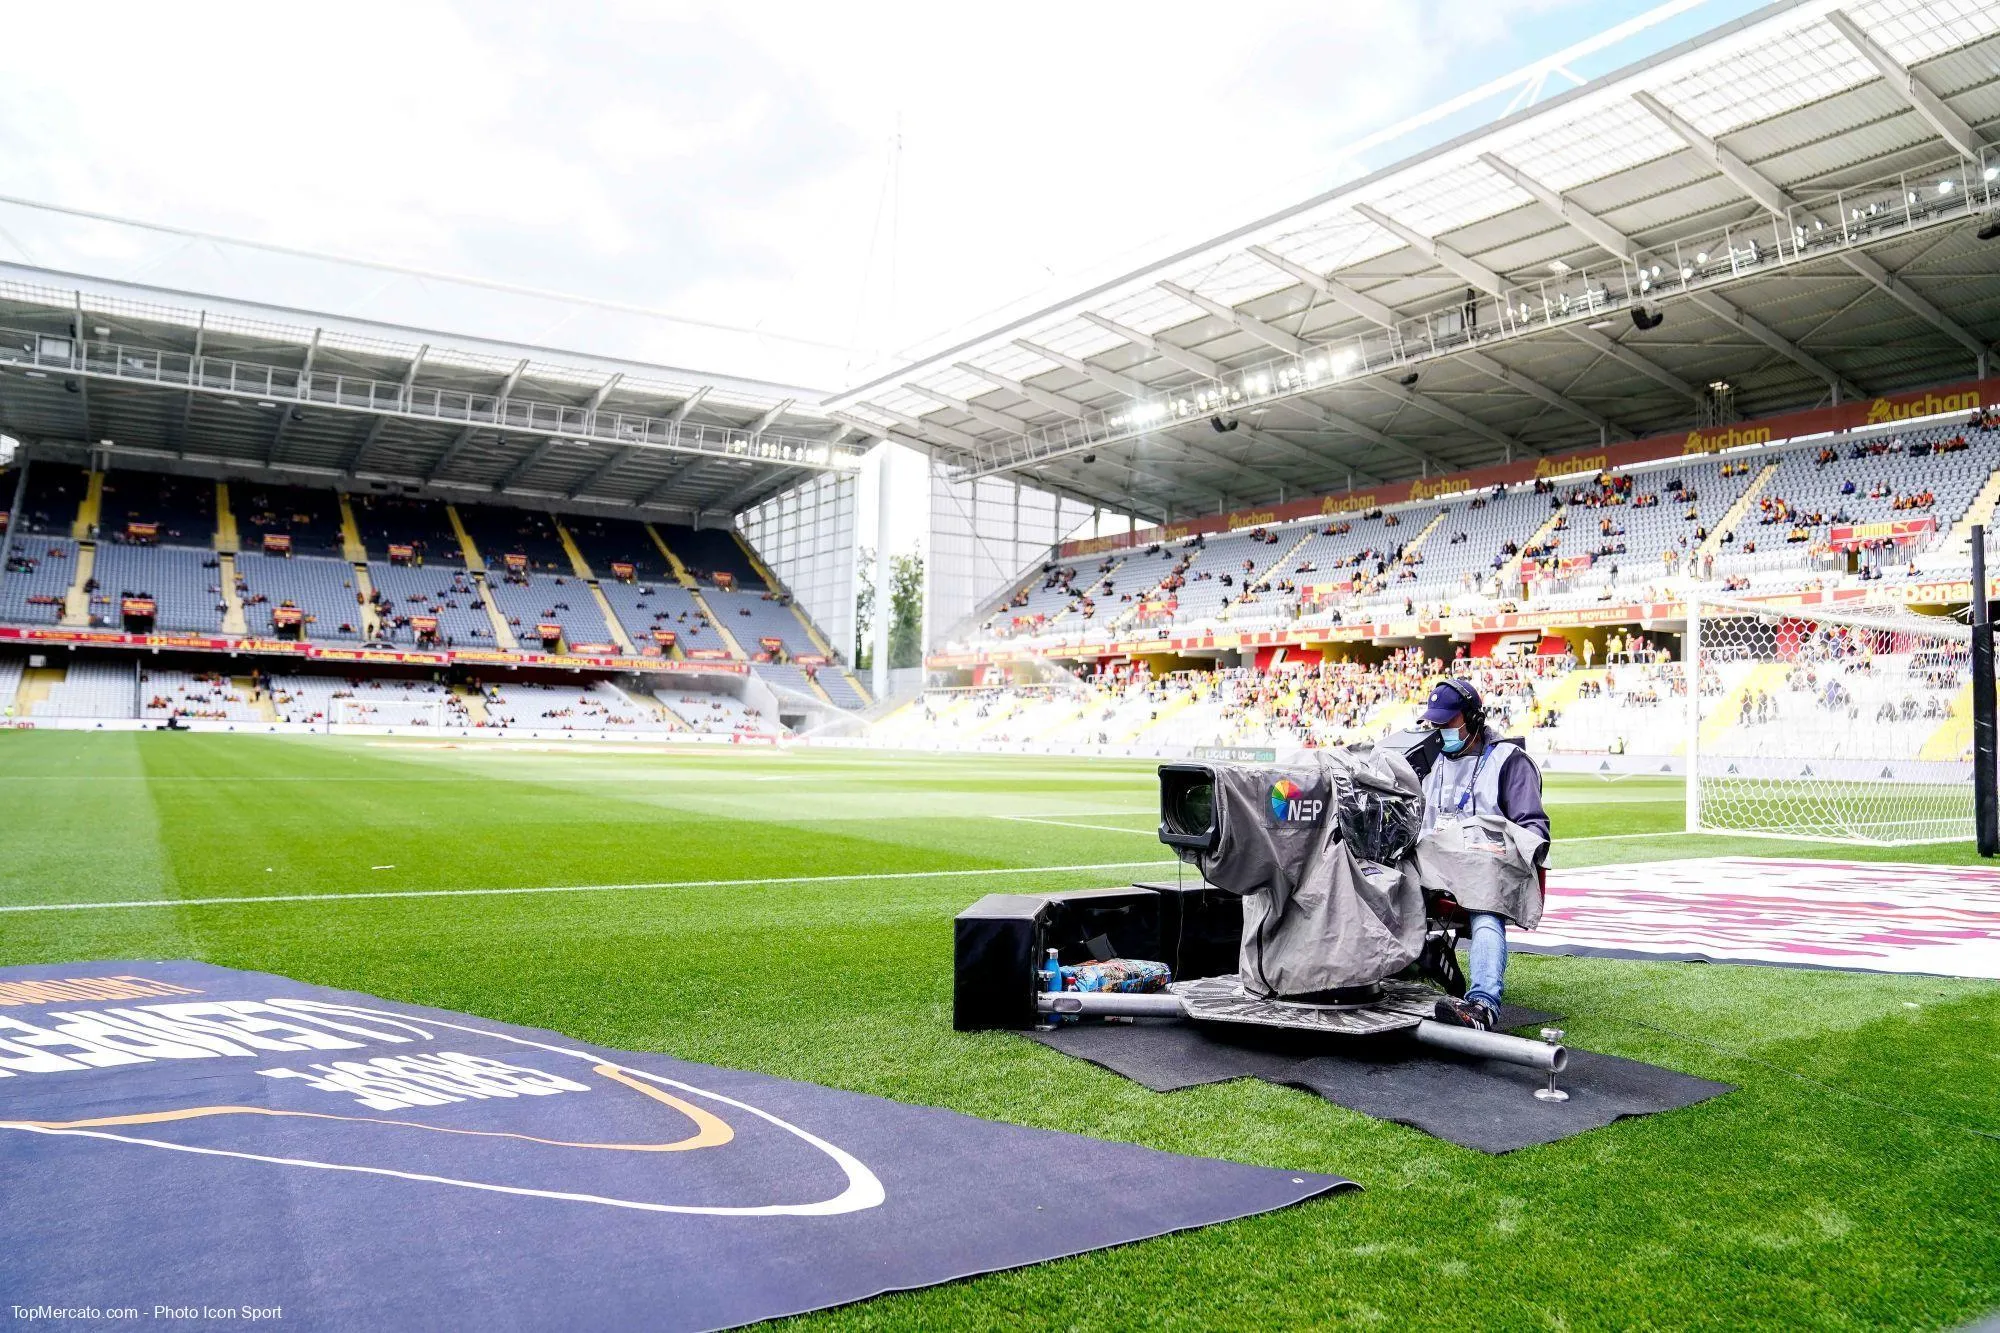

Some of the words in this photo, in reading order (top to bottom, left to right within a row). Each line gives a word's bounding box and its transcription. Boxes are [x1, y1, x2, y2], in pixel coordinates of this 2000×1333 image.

[1866, 391, 1980, 425] Auchan
[1682, 427, 1770, 455] Auchan
[1534, 455, 1606, 477] Auchan
[1409, 478, 1470, 499] Auchan
[1320, 495, 1376, 515] Auchan
[1227, 511, 1275, 532] Auchan
[1287, 799, 1323, 821] NEP
[256, 1050, 593, 1111] GROUPE
